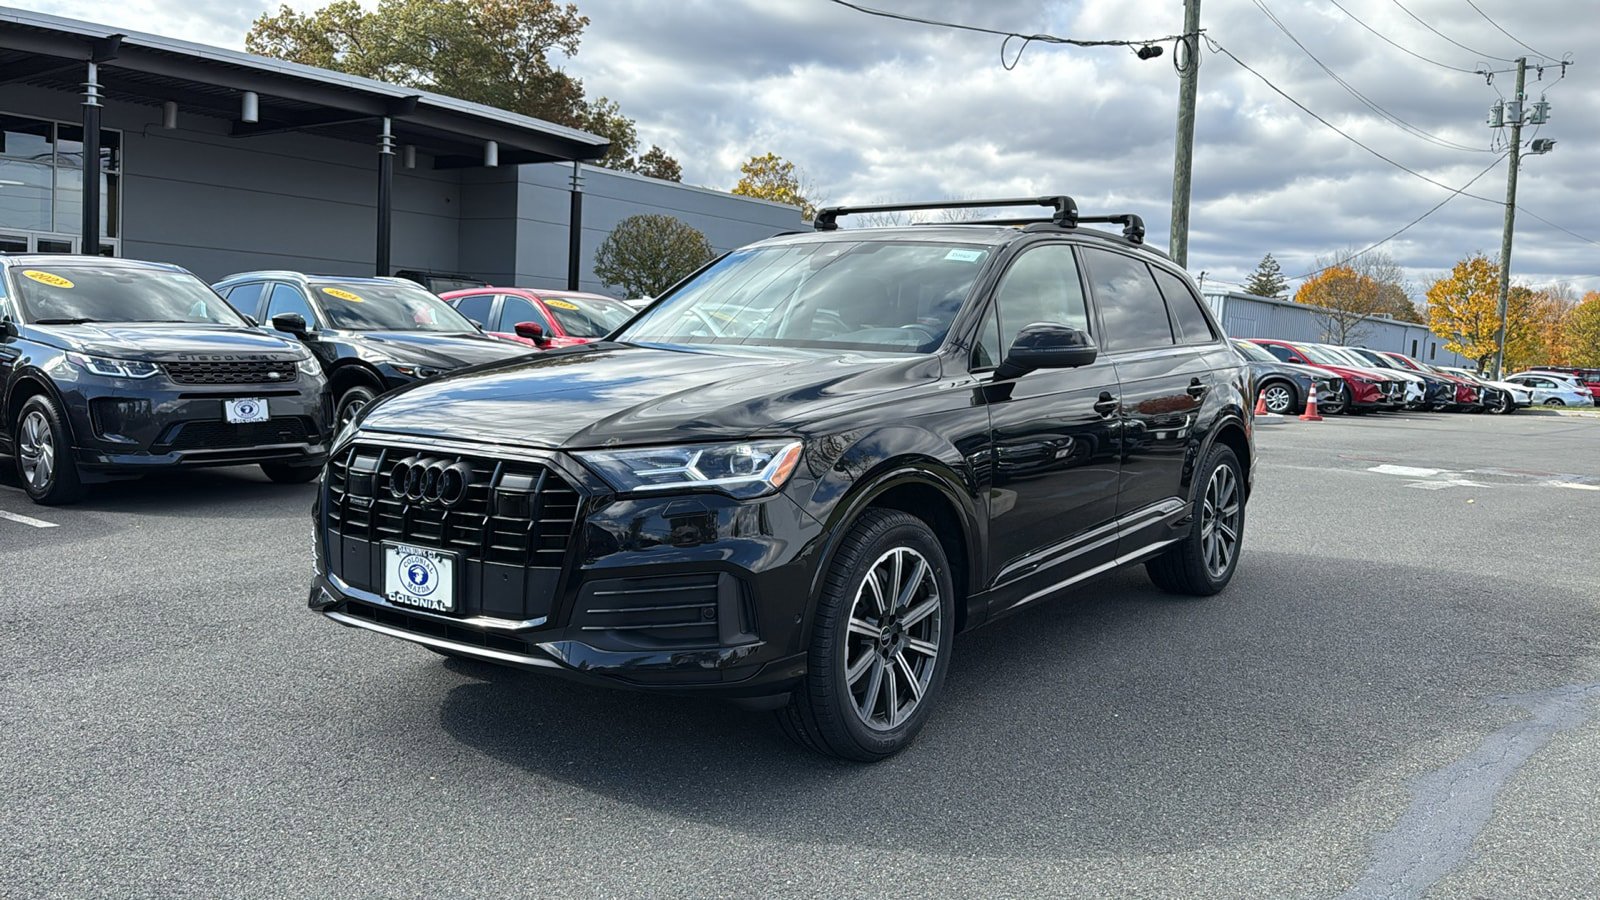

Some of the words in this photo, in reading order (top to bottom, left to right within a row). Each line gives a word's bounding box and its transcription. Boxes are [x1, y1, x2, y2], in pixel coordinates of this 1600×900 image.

[29, 272, 68, 286] 2023
[403, 556, 434, 575] COLONIAL
[407, 581, 431, 593] MAZDA
[388, 592, 447, 612] COLONIAL
